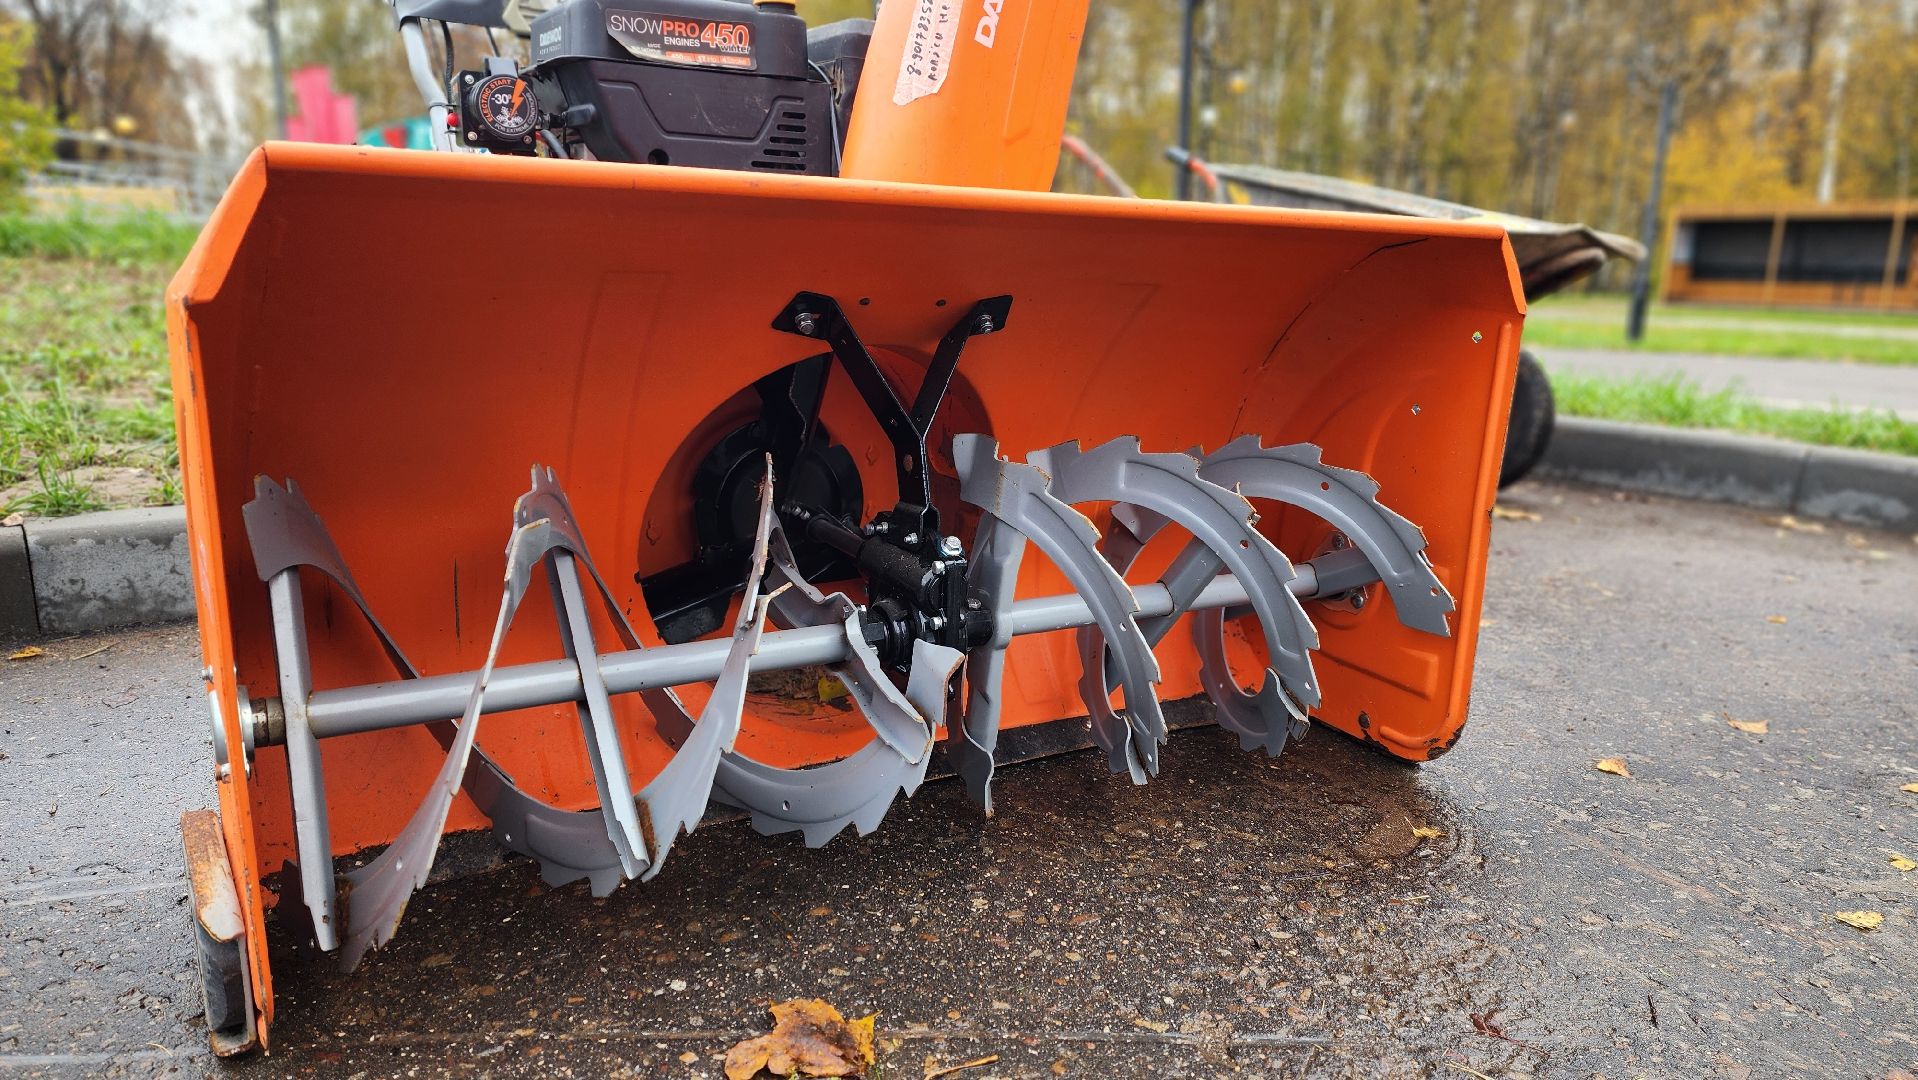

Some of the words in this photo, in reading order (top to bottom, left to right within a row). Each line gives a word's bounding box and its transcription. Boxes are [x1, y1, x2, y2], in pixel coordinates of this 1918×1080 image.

[700, 22, 750, 49] 450
[664, 36, 701, 48] ENGINES
[719, 44, 751, 54] winter
[481, 88, 494, 122] ELECTRIC
[489, 79, 512, 89] START
[494, 123, 507, 132] FOR
